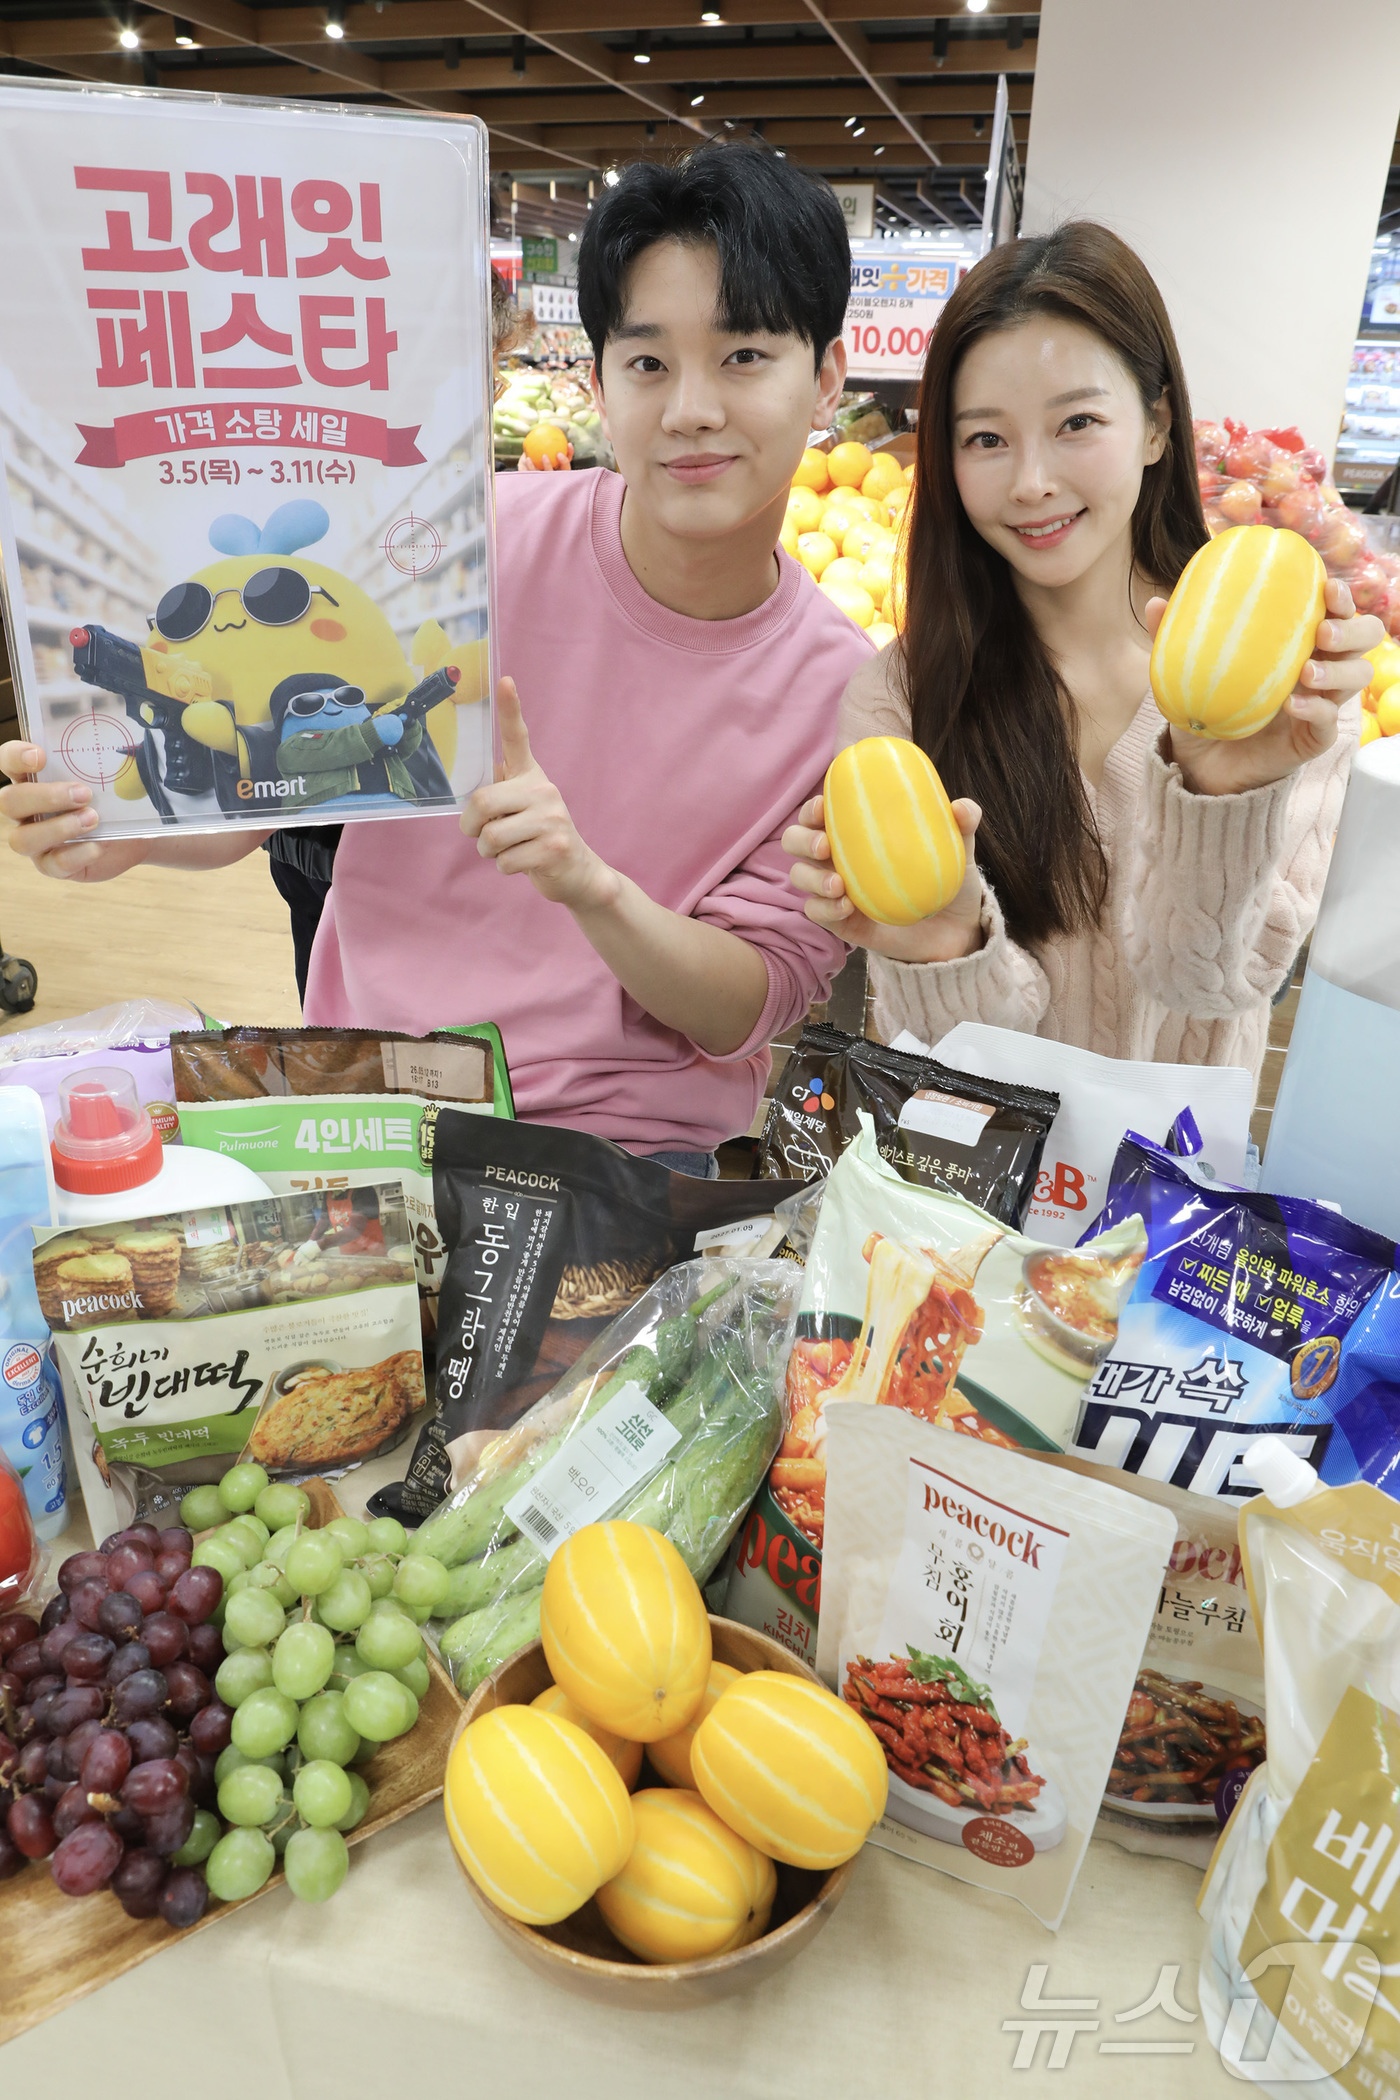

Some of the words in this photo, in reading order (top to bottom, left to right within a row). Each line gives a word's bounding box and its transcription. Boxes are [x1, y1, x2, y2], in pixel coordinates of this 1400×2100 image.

[73, 166, 391, 281] 고래잇
[907, 268, 948, 291] 가격
[86, 288, 398, 391] 페스타
[154, 410, 215, 445] 가격
[224, 409, 283, 440] 소탕
[290, 411, 349, 447] 세일
[158, 459, 241, 486] 3.5(목)
[236, 776, 307, 799] emart
[792, 1086, 811, 1101] CJ
[151, 1116, 175, 1125] EMIUM
[155, 1121, 174, 1131] ALITY
[294, 1117, 413, 1153] 4인세트
[782, 1110, 827, 1134] 제일제당
[219, 1138, 279, 1153] Pulmuone
[485, 1165, 560, 1192] PEACOCK
[916, 1155, 942, 1176] 깊은
[944, 1162, 972, 1185] 풍미
[1041, 1208, 1065, 1220] 1992
[1190, 1228, 1233, 1261] 신개념
[1234, 1244, 1277, 1278] 올인원
[1276, 1267, 1331, 1307] 파워효소
[1333, 1292, 1362, 1320] 함유
[1196, 1263, 1231, 1294] 찌든
[1236, 1279, 1252, 1303] 때
[61, 1290, 145, 1322] peacock
[448, 1223, 510, 1399] 동그랑땡
[1168, 1278, 1220, 1315] 남김없이
[1220, 1303, 1269, 1340] 깨끗하게
[5, 1347, 29, 1367] ORIGINAL
[7, 1354, 38, 1379] EXCELLENT
[99, 1350, 264, 1419] 빈대떡
[1177, 1357, 1249, 1414] 쏙
[110, 1432, 150, 1450] 녹두
[157, 1426, 210, 1443] 빈대떡
[615, 1420, 645, 1452] 그대로
[628, 1413, 655, 1440] 신선
[568, 1465, 599, 1502] 백오이
[922, 1481, 1046, 1571] peacock
[736, 1513, 821, 1614] pea
[934, 1560, 974, 1653] 홍어회
[763, 1622, 805, 1659] KIMCHI
[776, 1607, 810, 1649] 김치
